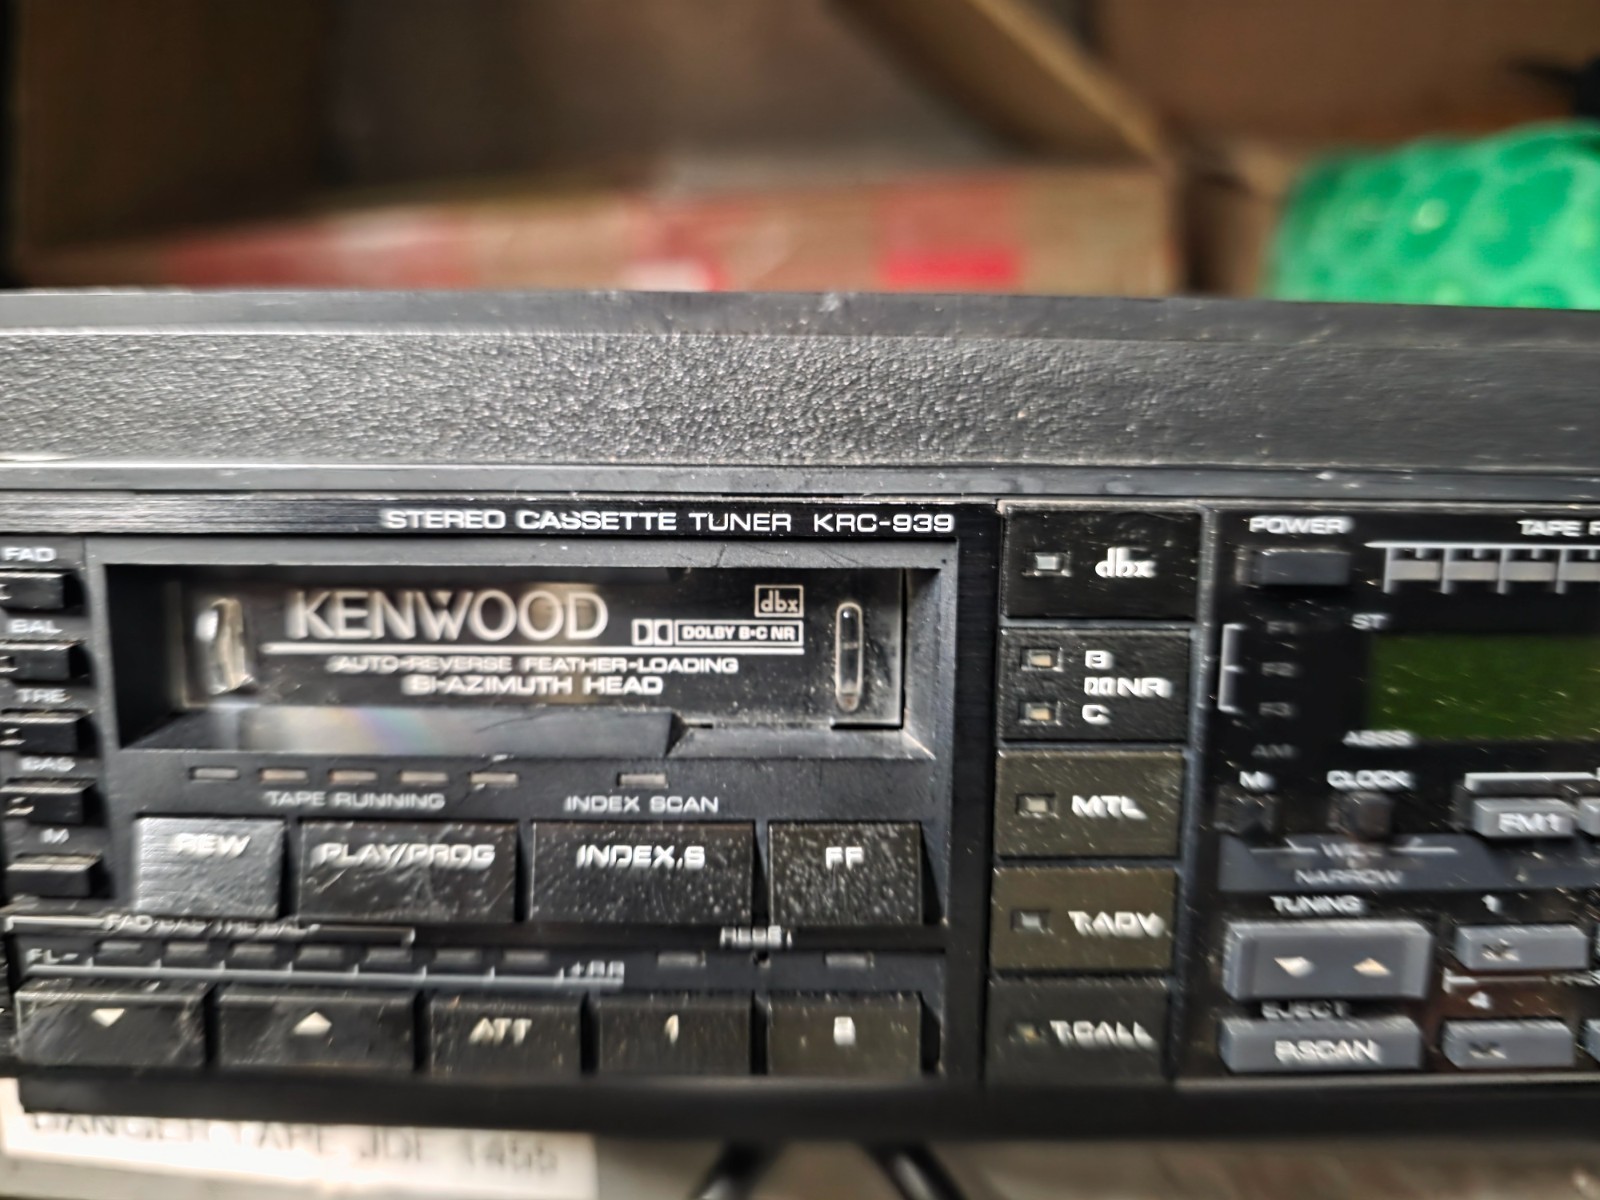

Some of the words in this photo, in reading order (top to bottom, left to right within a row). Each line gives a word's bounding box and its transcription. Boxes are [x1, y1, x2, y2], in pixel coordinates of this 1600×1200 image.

[382, 509, 506, 532] STEREO
[515, 510, 678, 532] CASSETTE
[688, 512, 793, 532] TUNER
[813, 513, 956, 533] KRC-939
[1249, 516, 1351, 534] POWER
[1516, 520, 1581, 537] TAPE
[1095, 547, 1156, 578] dbx
[760, 589, 799, 613] dbx
[287, 588, 609, 641] KENWOOD
[681, 625, 736, 641] DOLBY
[770, 626, 796, 641] NR
[521, 656, 740, 674] FEATHER-LOADING
[402, 674, 573, 696] BI-AZIMUTH
[583, 676, 664, 696] HEAD
[263, 791, 325, 808] TAPE
[333, 793, 446, 812] RUNNING
[564, 795, 640, 813] INDEX
[649, 796, 720, 813] SCAN
[1071, 794, 1148, 820] MTL
[311, 843, 496, 870] PLAY/PROG
[825, 846, 866, 870] FF
[1270, 895, 1369, 914] TUNING
